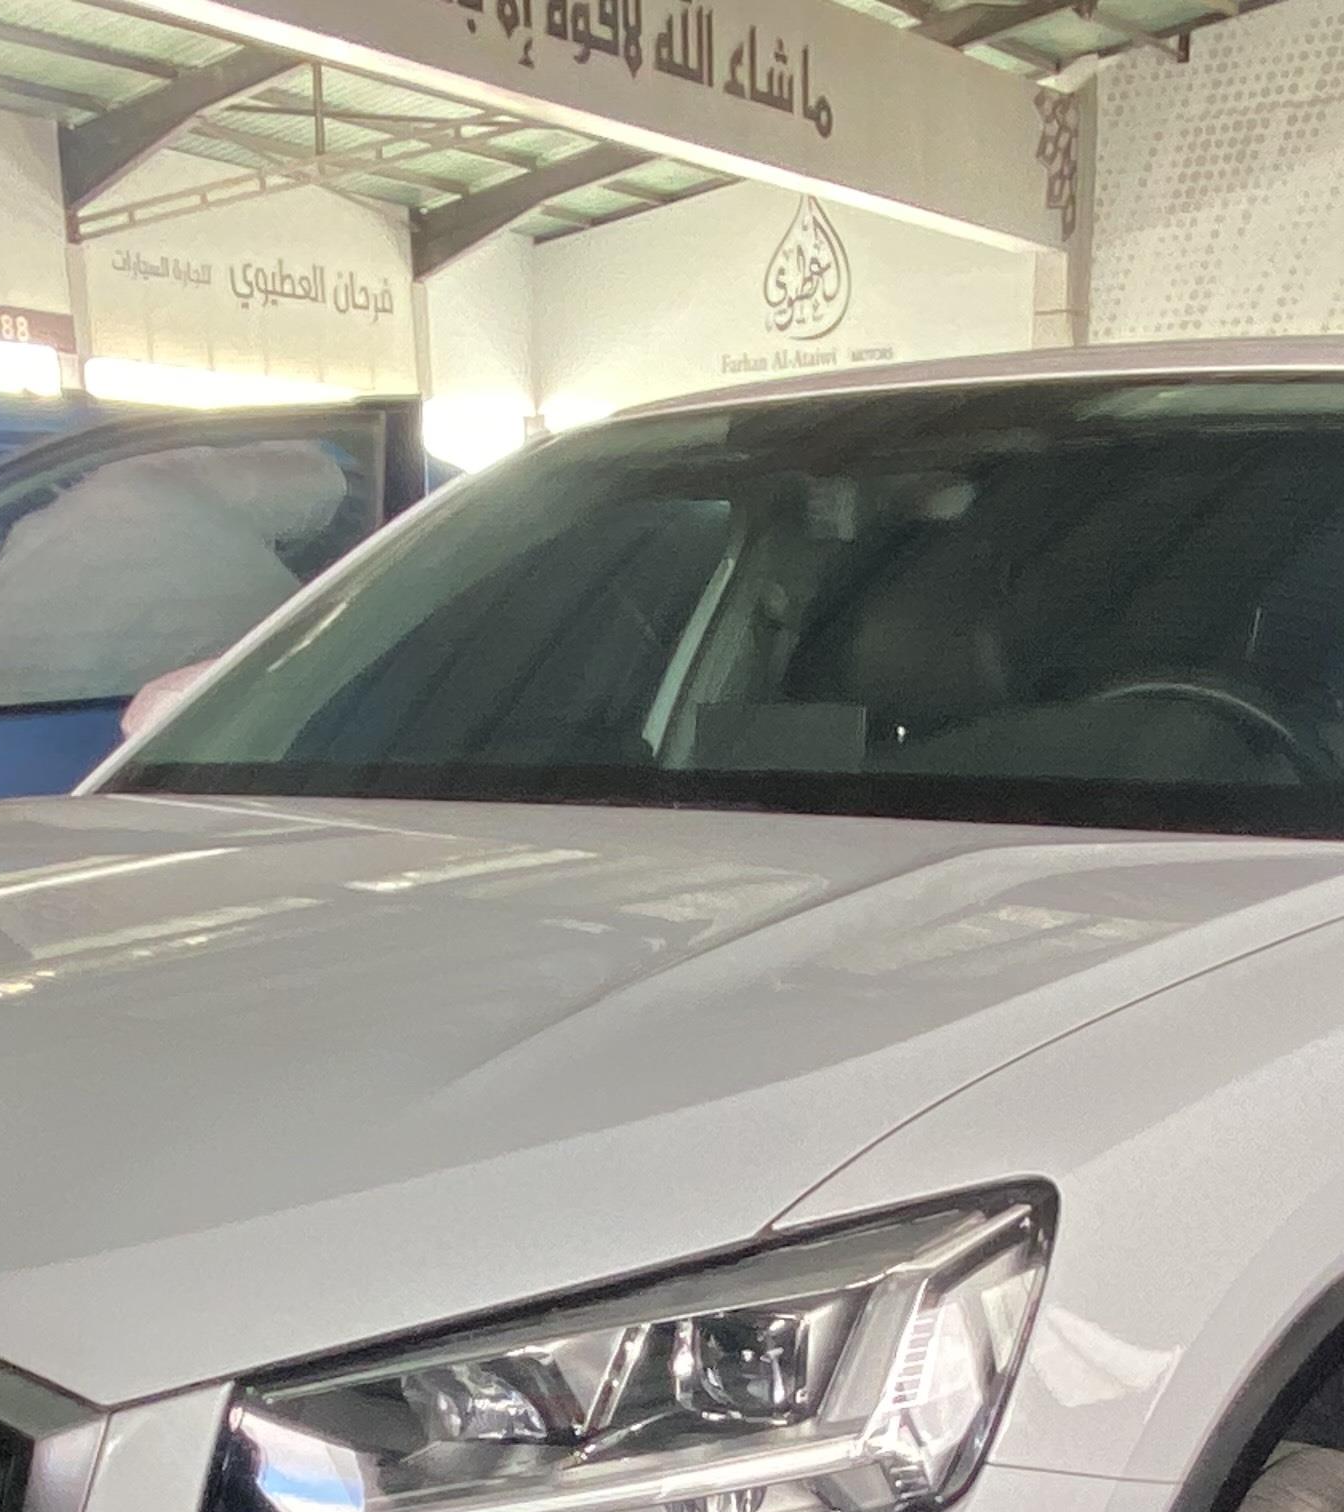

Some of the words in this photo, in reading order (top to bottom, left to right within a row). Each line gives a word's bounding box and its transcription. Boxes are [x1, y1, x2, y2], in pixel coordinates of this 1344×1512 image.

[654, 1, 714, 88] الله
[229, 258, 327, 309] العطيوي
[333, 270, 394, 323] فرحان
